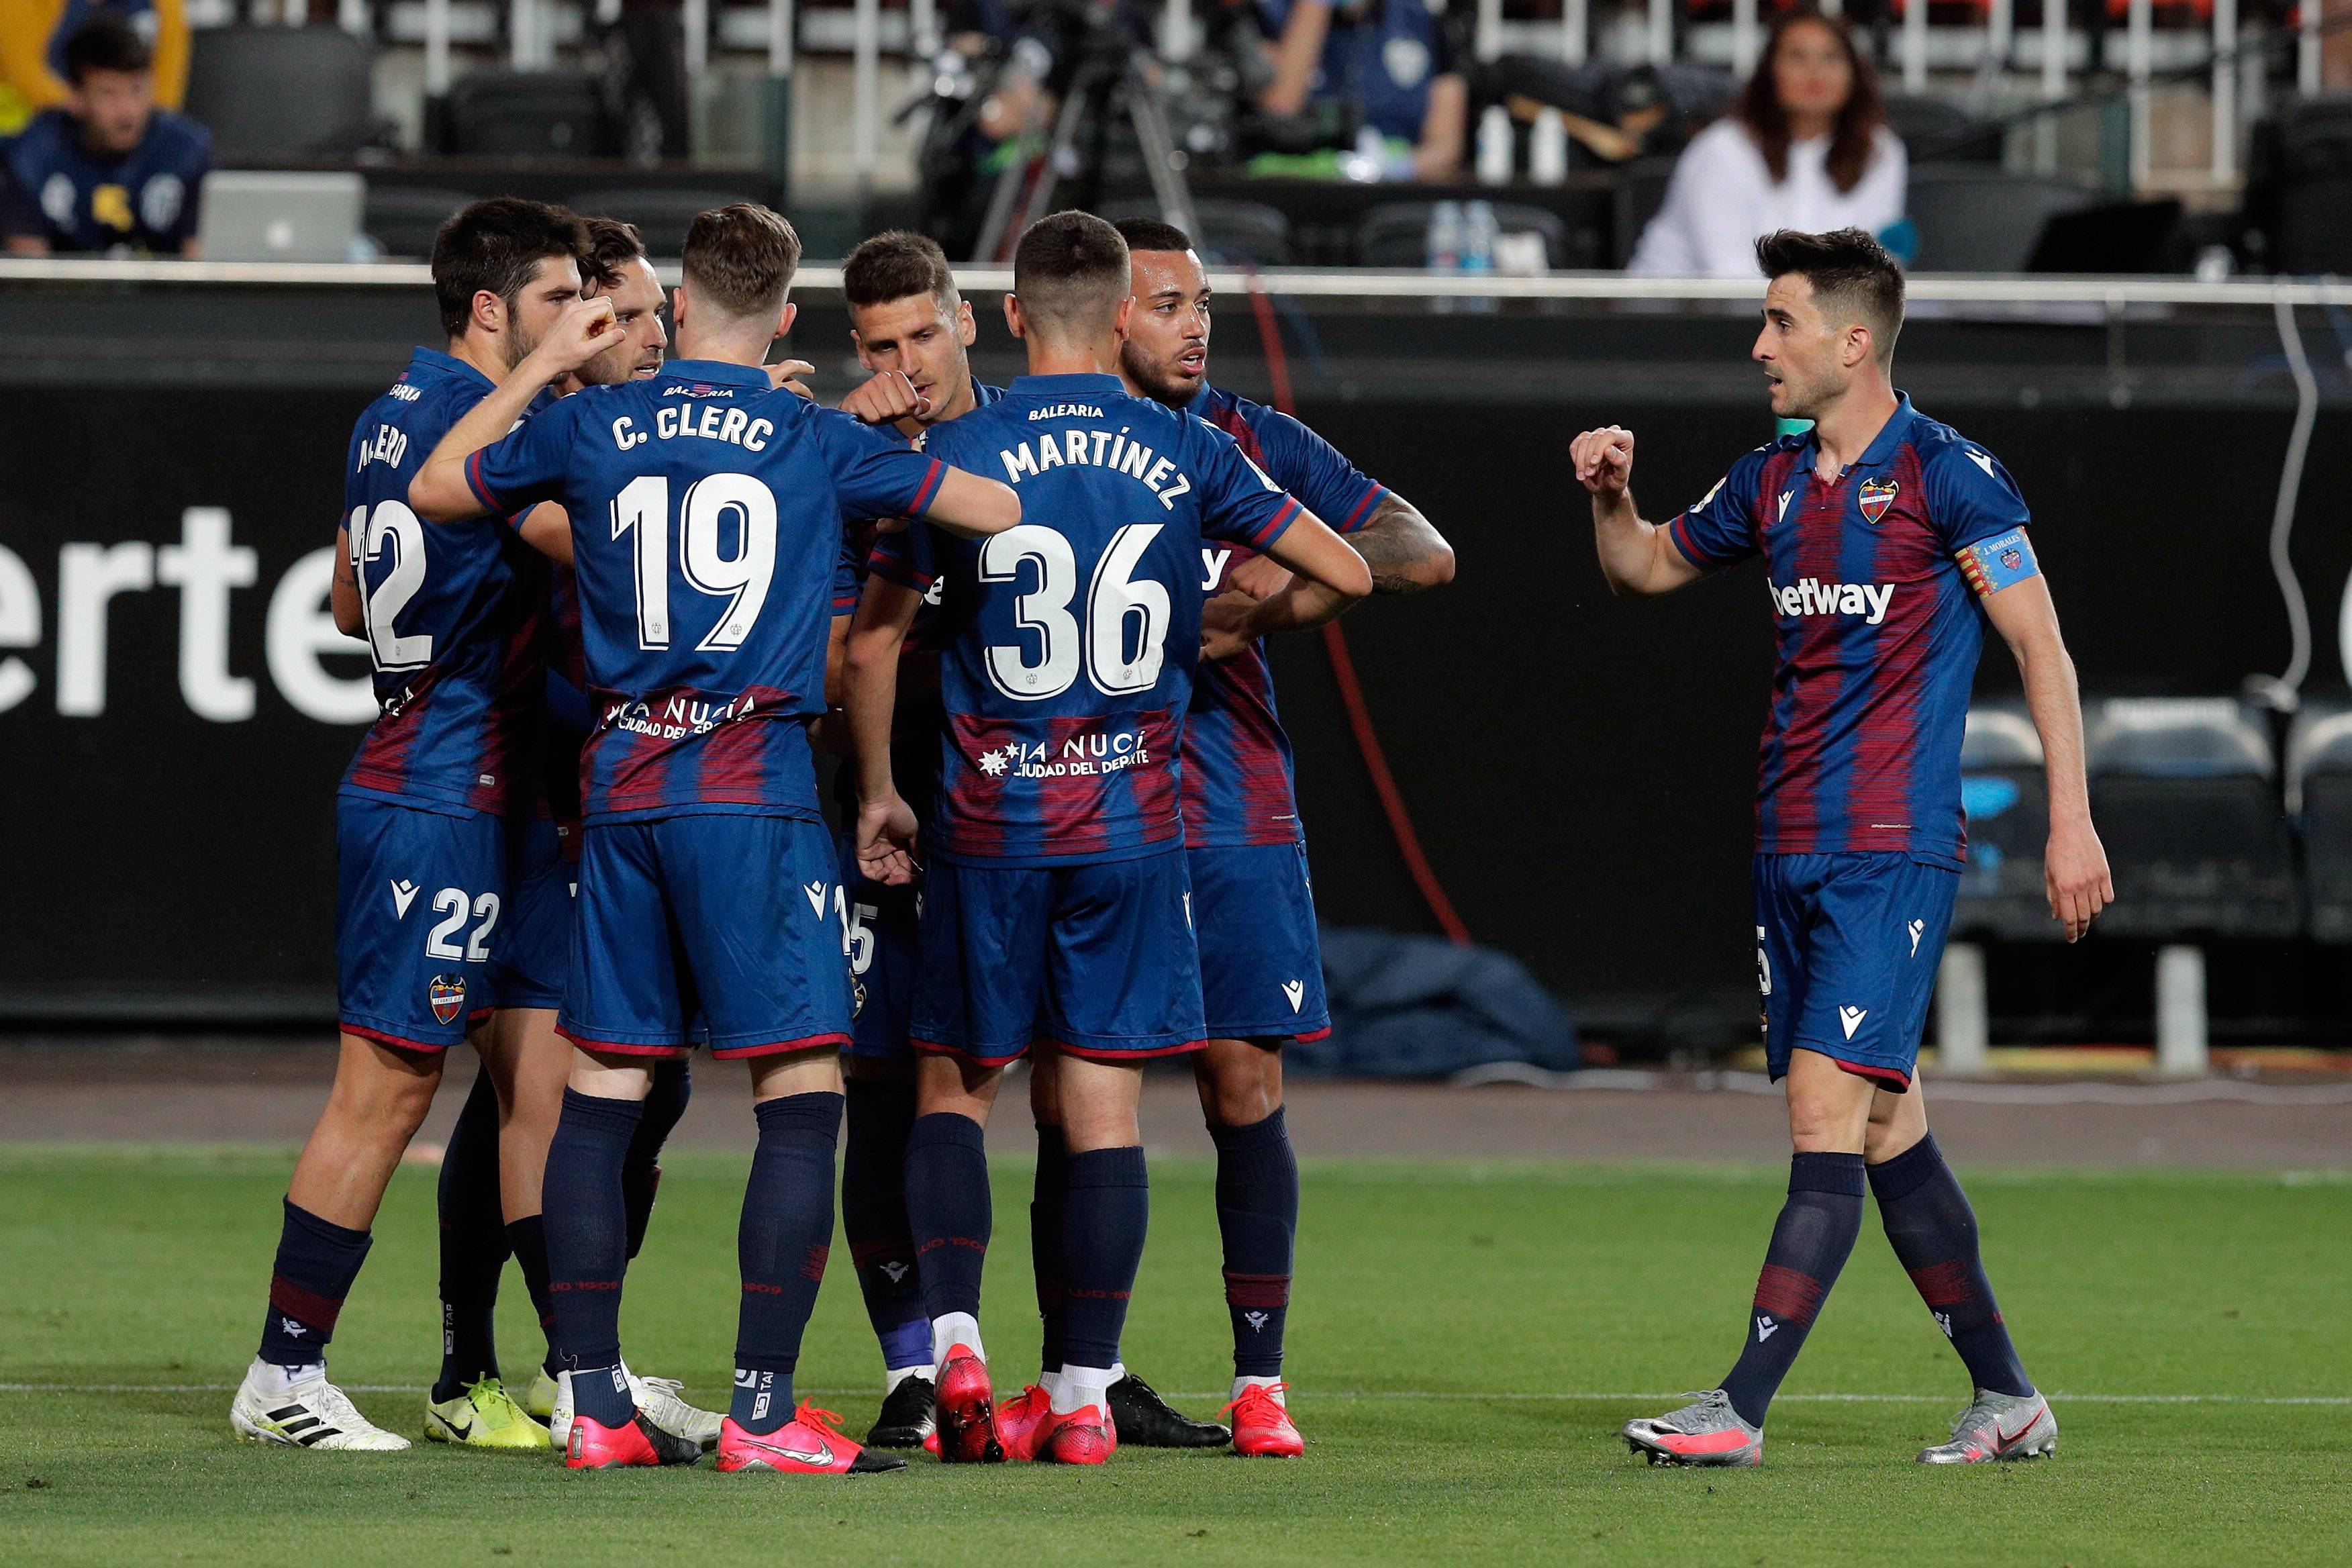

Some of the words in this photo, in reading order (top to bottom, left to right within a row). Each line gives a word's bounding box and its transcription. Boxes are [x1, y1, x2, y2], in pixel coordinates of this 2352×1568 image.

[612, 416, 648, 450] C.
[656, 403, 774, 452] CLERC
[1028, 404, 1104, 421] BALEARIA
[999, 426, 1191, 511] MARTÍNEZ
[609, 473, 777, 651] 19
[1988, 535, 2020, 552] MORALES
[978, 524, 1171, 701] 36
[1767, 577, 1896, 625] betway
[618, 717, 661, 736] CIUDAD
[1063, 731, 1146, 759] NUCÍ
[1070, 761, 1098, 776] DEL
[425, 887, 500, 963] 22
